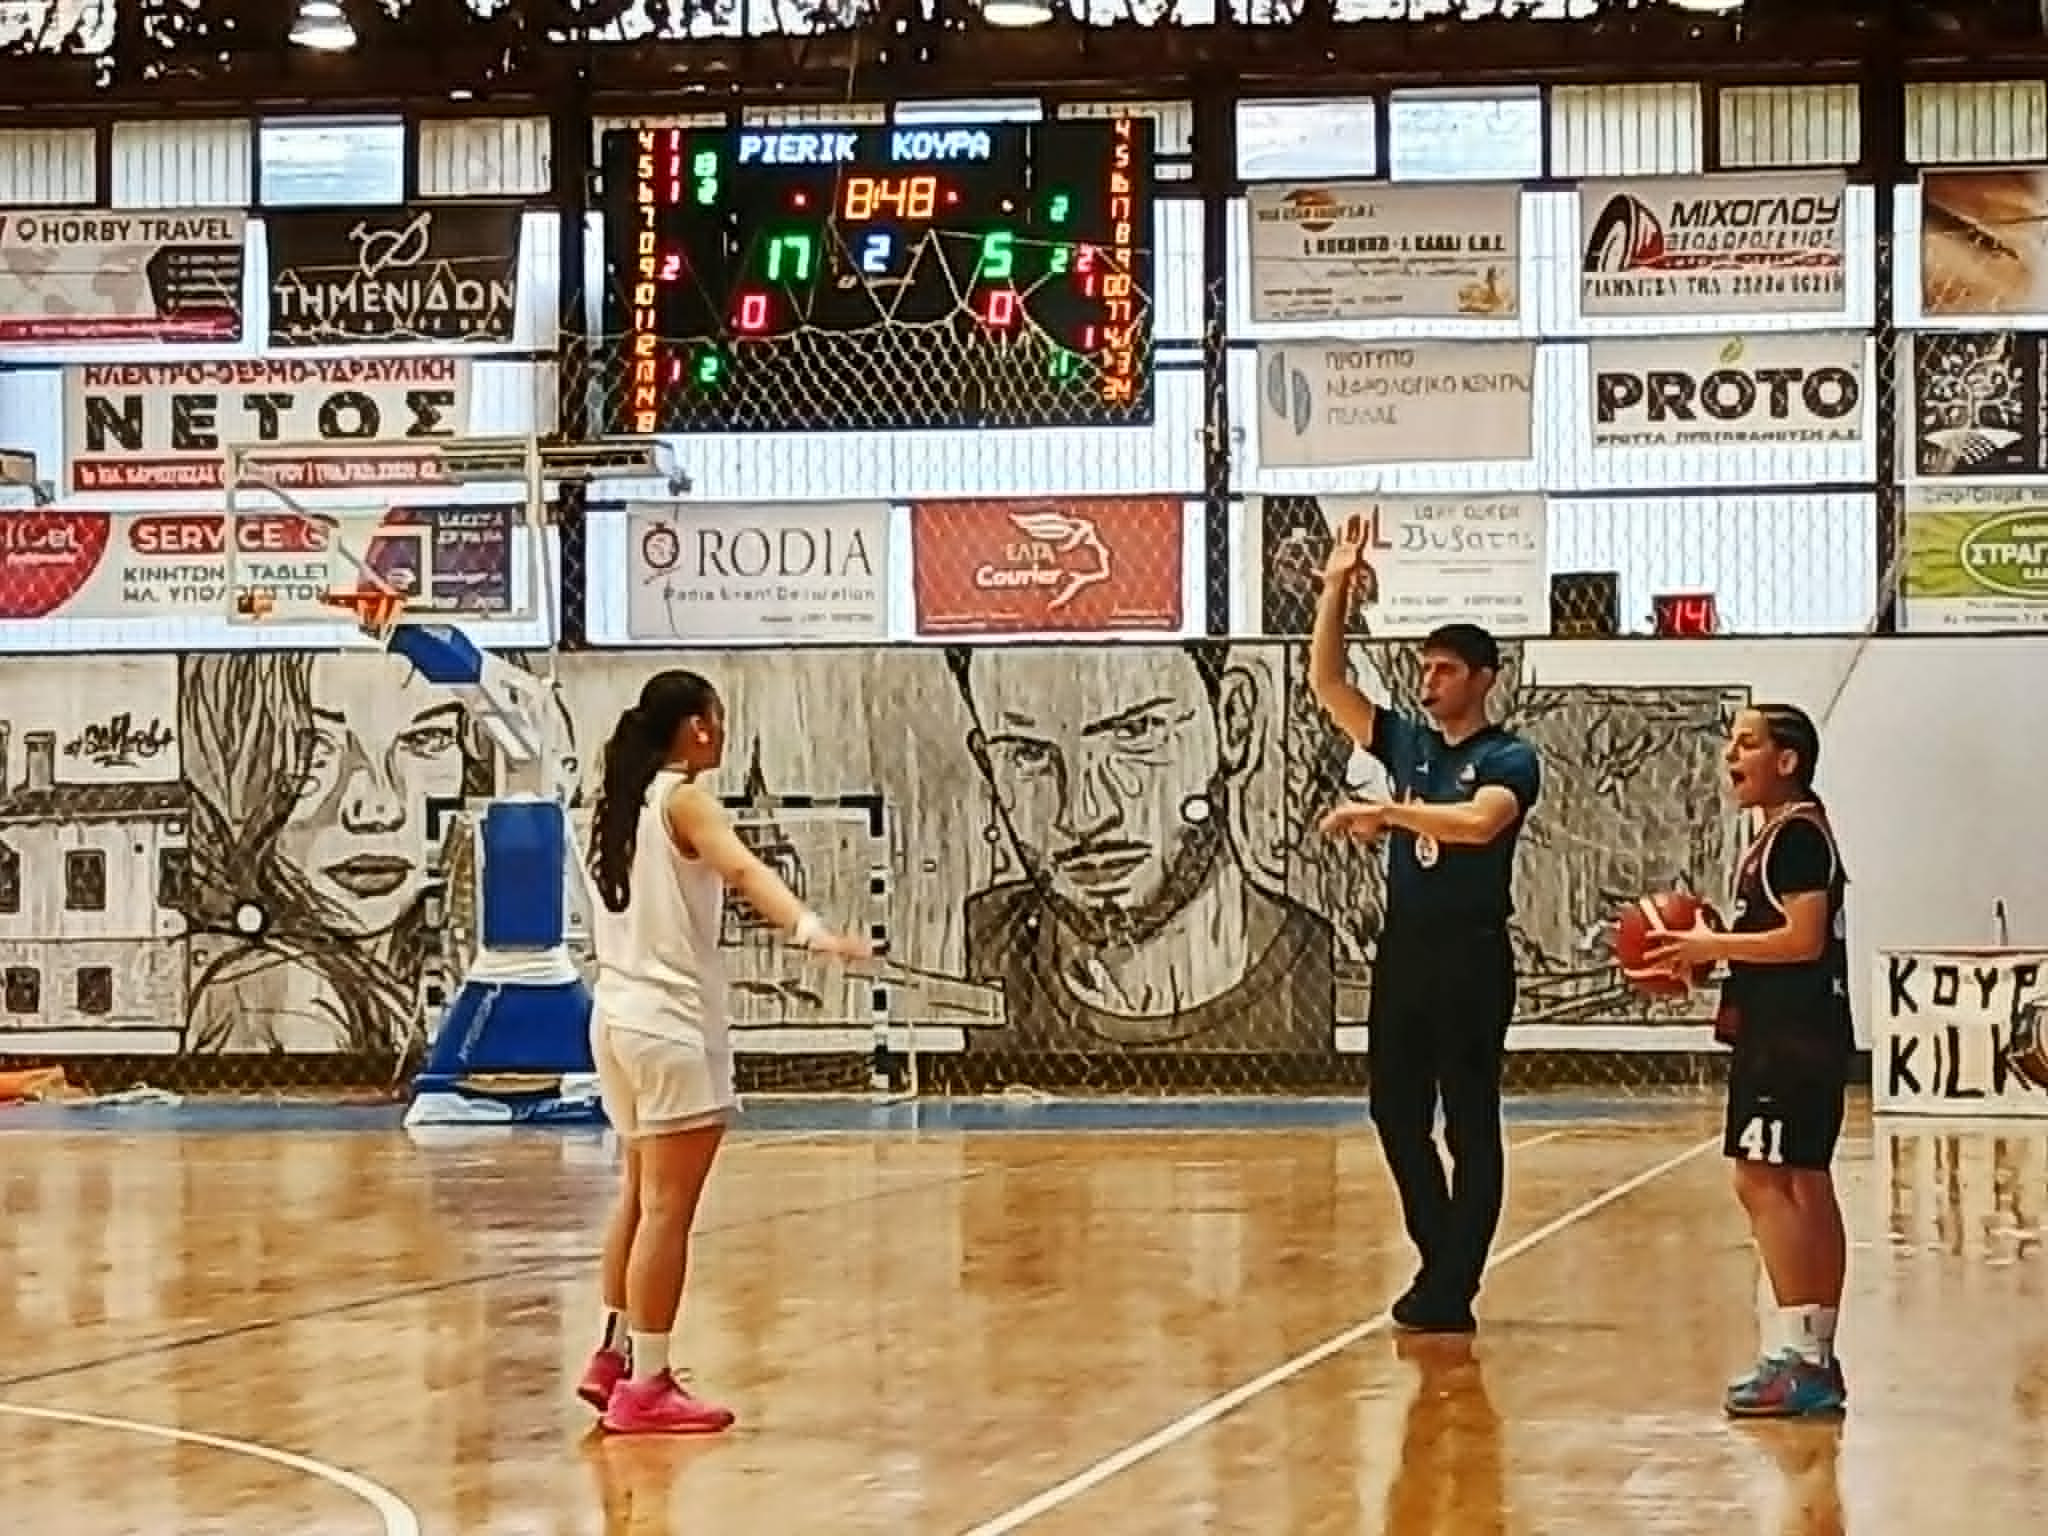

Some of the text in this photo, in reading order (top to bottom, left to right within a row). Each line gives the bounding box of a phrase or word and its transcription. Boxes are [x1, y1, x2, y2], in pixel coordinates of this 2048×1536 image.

[739, 131, 858, 164] PIERIK
[637, 154, 654, 178] 5
[844, 176, 937, 220] 8:48
[1670, 197, 1840, 227] ΜΙΧΟΓΛΟΥ
[41, 217, 233, 242] HORBY TRAVEL
[660, 254, 681, 281] 2
[767, 235, 811, 280] 17
[862, 234, 892, 273] 2
[983, 231, 1014, 279] 5
[273, 279, 513, 316] ΤΗΜΕΝΙΔΩΝ
[741, 295, 768, 330] 0
[988, 290, 1013, 325] 0
[699, 355, 719, 382] 2
[1597, 367, 1859, 422] PROTO
[85, 390, 455, 450] ΝΕΤΟΣ
[136, 522, 284, 550] SERVCE
[698, 527, 873, 577] RODIA
[1971, 543, 2048, 566] ΣΤΡΑΓ
[975, 563, 1063, 587] Courier
[1674, 598, 1709, 634] 14
[1738, 1116, 1784, 1165] 41
